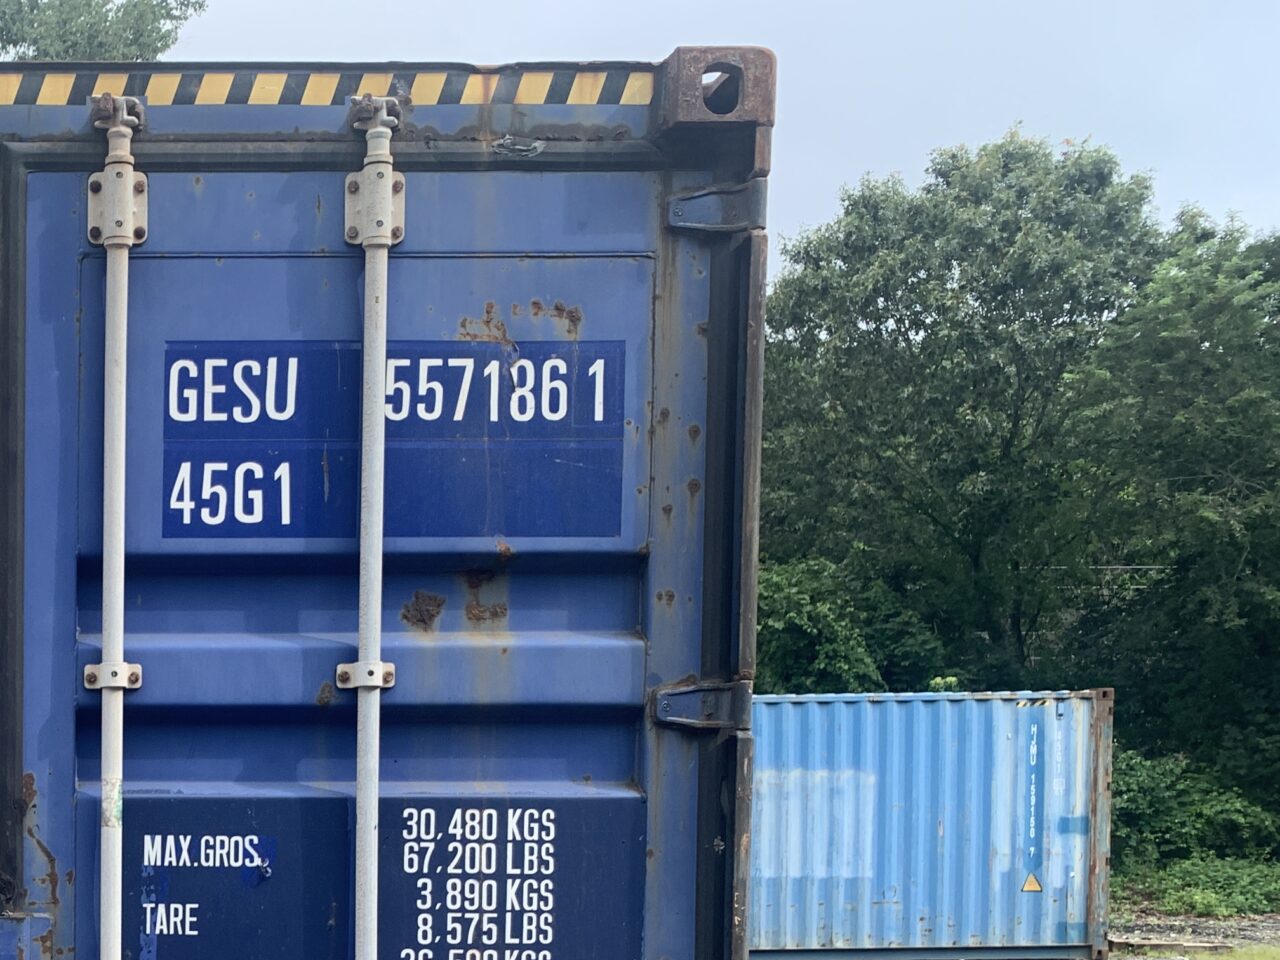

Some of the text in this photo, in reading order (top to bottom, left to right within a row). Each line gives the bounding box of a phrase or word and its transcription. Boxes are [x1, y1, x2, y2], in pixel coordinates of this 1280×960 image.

[168, 357, 299, 424] GESU
[170, 461, 291, 525] 45G1
[1029, 724, 1038, 766] HJMU
[507, 808, 556, 840] KGS
[506, 842, 555, 875] LBS
[505, 878, 554, 911] KGS
[142, 903, 200, 935] TARE
[504, 912, 553, 944] LBS
